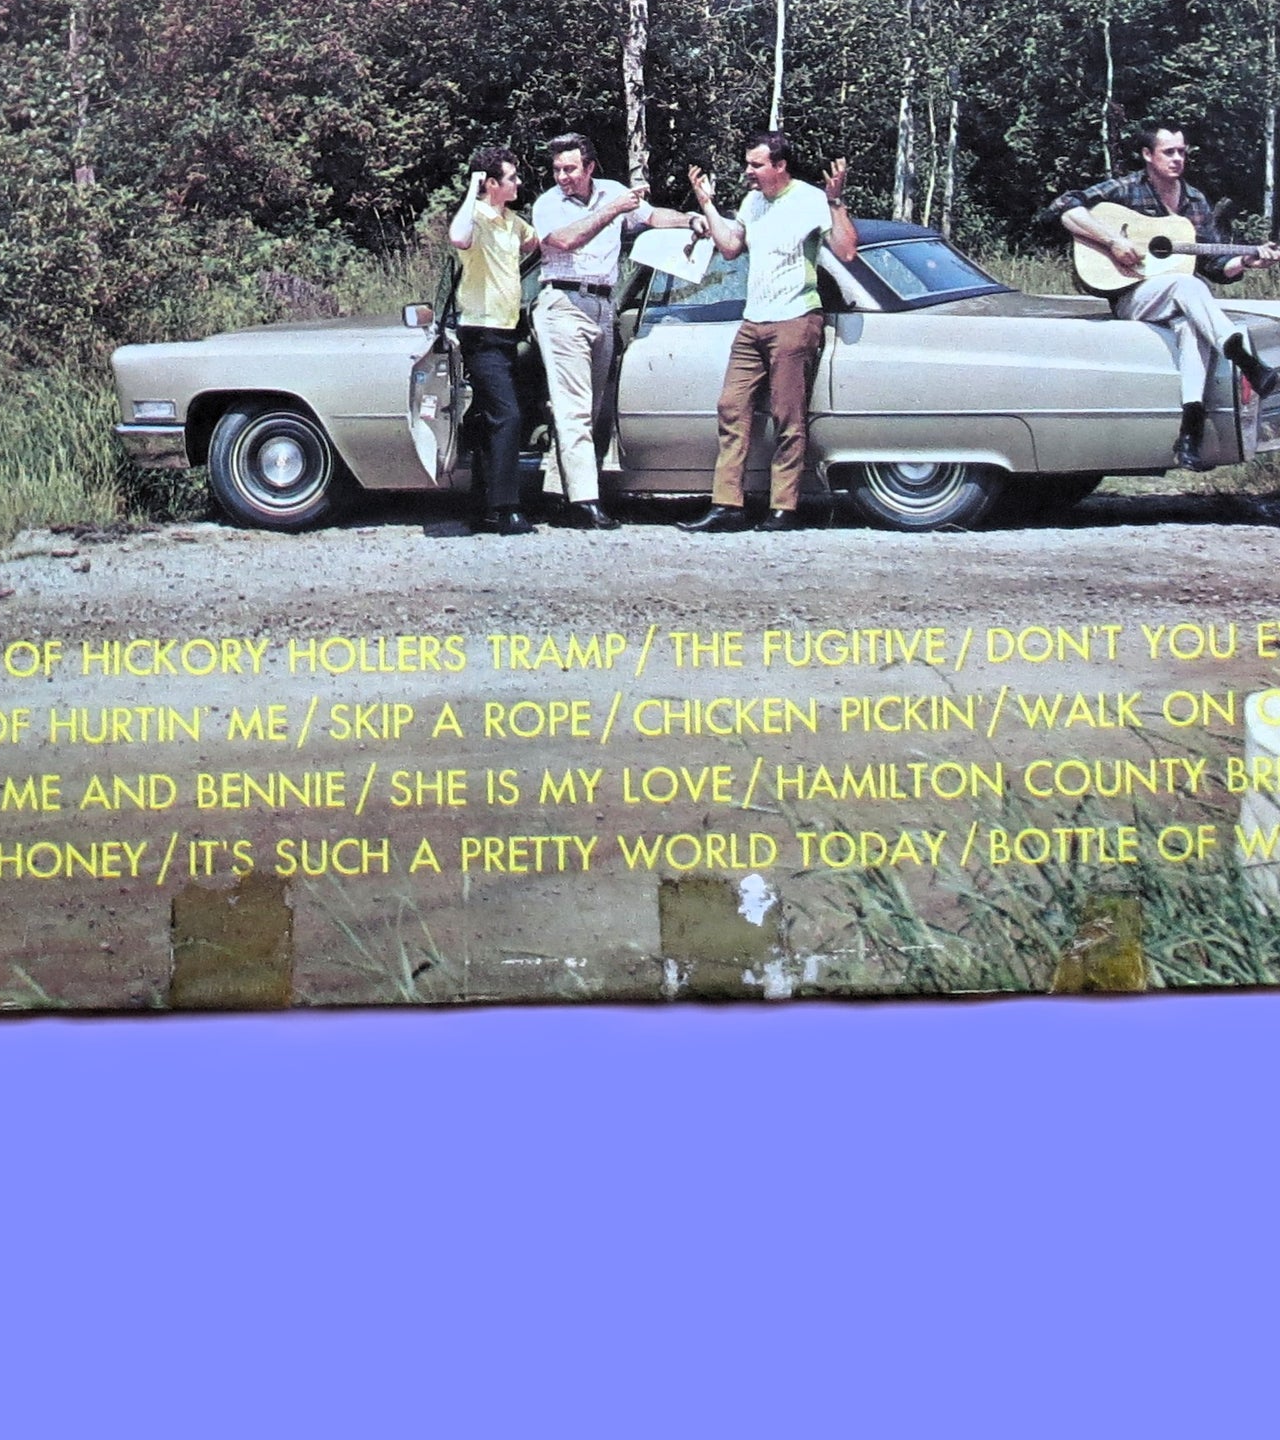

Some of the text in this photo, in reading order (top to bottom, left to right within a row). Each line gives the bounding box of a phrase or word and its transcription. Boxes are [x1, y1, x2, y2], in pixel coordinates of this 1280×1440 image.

[4, 641, 63, 678] OF
[83, 638, 268, 676] HICKORY
[289, 634, 466, 675] HOLLERS
[487, 633, 626, 671] TRAMP
[669, 631, 744, 668] THE
[763, 627, 945, 667] FUGITIVE
[988, 625, 1121, 664] DON'T
[1141, 623, 1236, 660] YOU
[51, 705, 211, 742] HURTIN'
[228, 704, 287, 741] ME
[330, 702, 414, 740] SKIP
[432, 701, 464, 737] A
[485, 700, 590, 738] ROPE
[633, 697, 817, 736] CHICKEN
[842, 694, 985, 733] PICKIN'
[1018, 691, 1143, 729] WALK
[1162, 689, 1235, 726] ON
[2, 774, 61, 811] ME
[80, 773, 176, 809] AND
[198, 771, 345, 809] BENNIE
[390, 769, 466, 807] SHE
[487, 768, 519, 805] IS
[539, 768, 602, 804] MY
[624, 765, 731, 803] LOVE
[777, 761, 1003, 801] HAMILTON
[1025, 757, 1207, 797] COUNTY
[190, 839, 254, 877] IT'S
[276, 838, 389, 875] SUCH
[409, 837, 442, 873] A
[463, 835, 597, 872] PRETTY
[617, 832, 777, 871] WORLD
[796, 830, 947, 868] TODAY
[989, 825, 1137, 865] BOTTLE
[1158, 824, 1217, 863] OF
